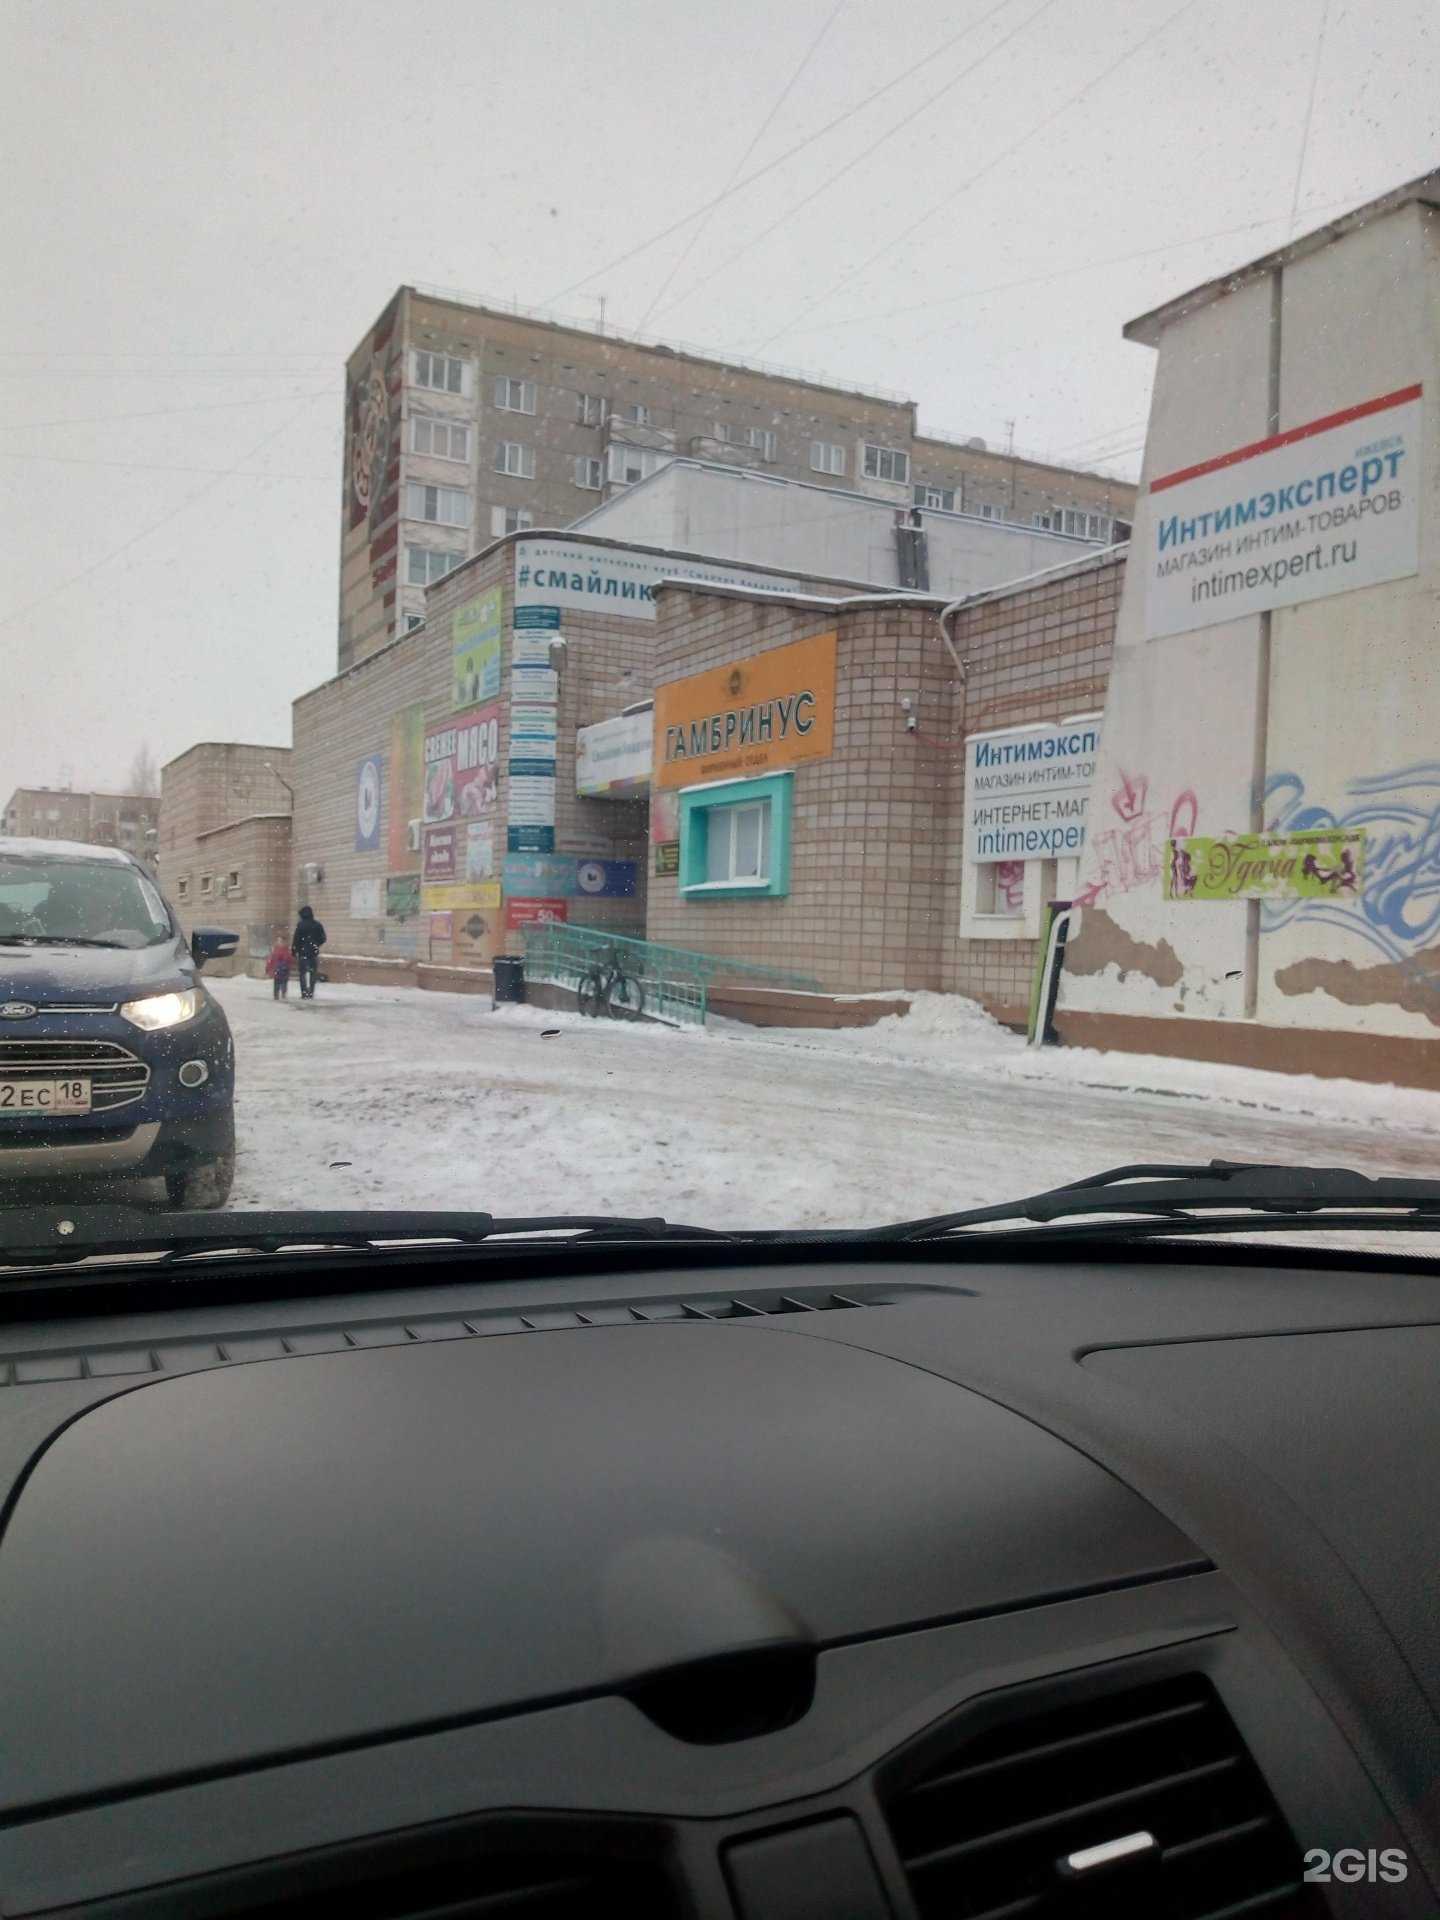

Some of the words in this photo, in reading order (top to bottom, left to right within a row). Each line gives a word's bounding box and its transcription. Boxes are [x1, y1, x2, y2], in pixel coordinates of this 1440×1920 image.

[1158, 450, 1405, 551] Интимэксперт
[1156, 541, 1232, 579] МАГАЗИН
[1236, 490, 1401, 556] ИНТИМ-ТОВАРОВ
[1191, 540, 1358, 603] intimexpert.ru
[457, 718, 499, 772] МЯСО
[665, 691, 816, 763] ГАМБРИНУС
[975, 730, 1100, 768] Интимэксп
[974, 769, 1025, 791] МАГАЗИН
